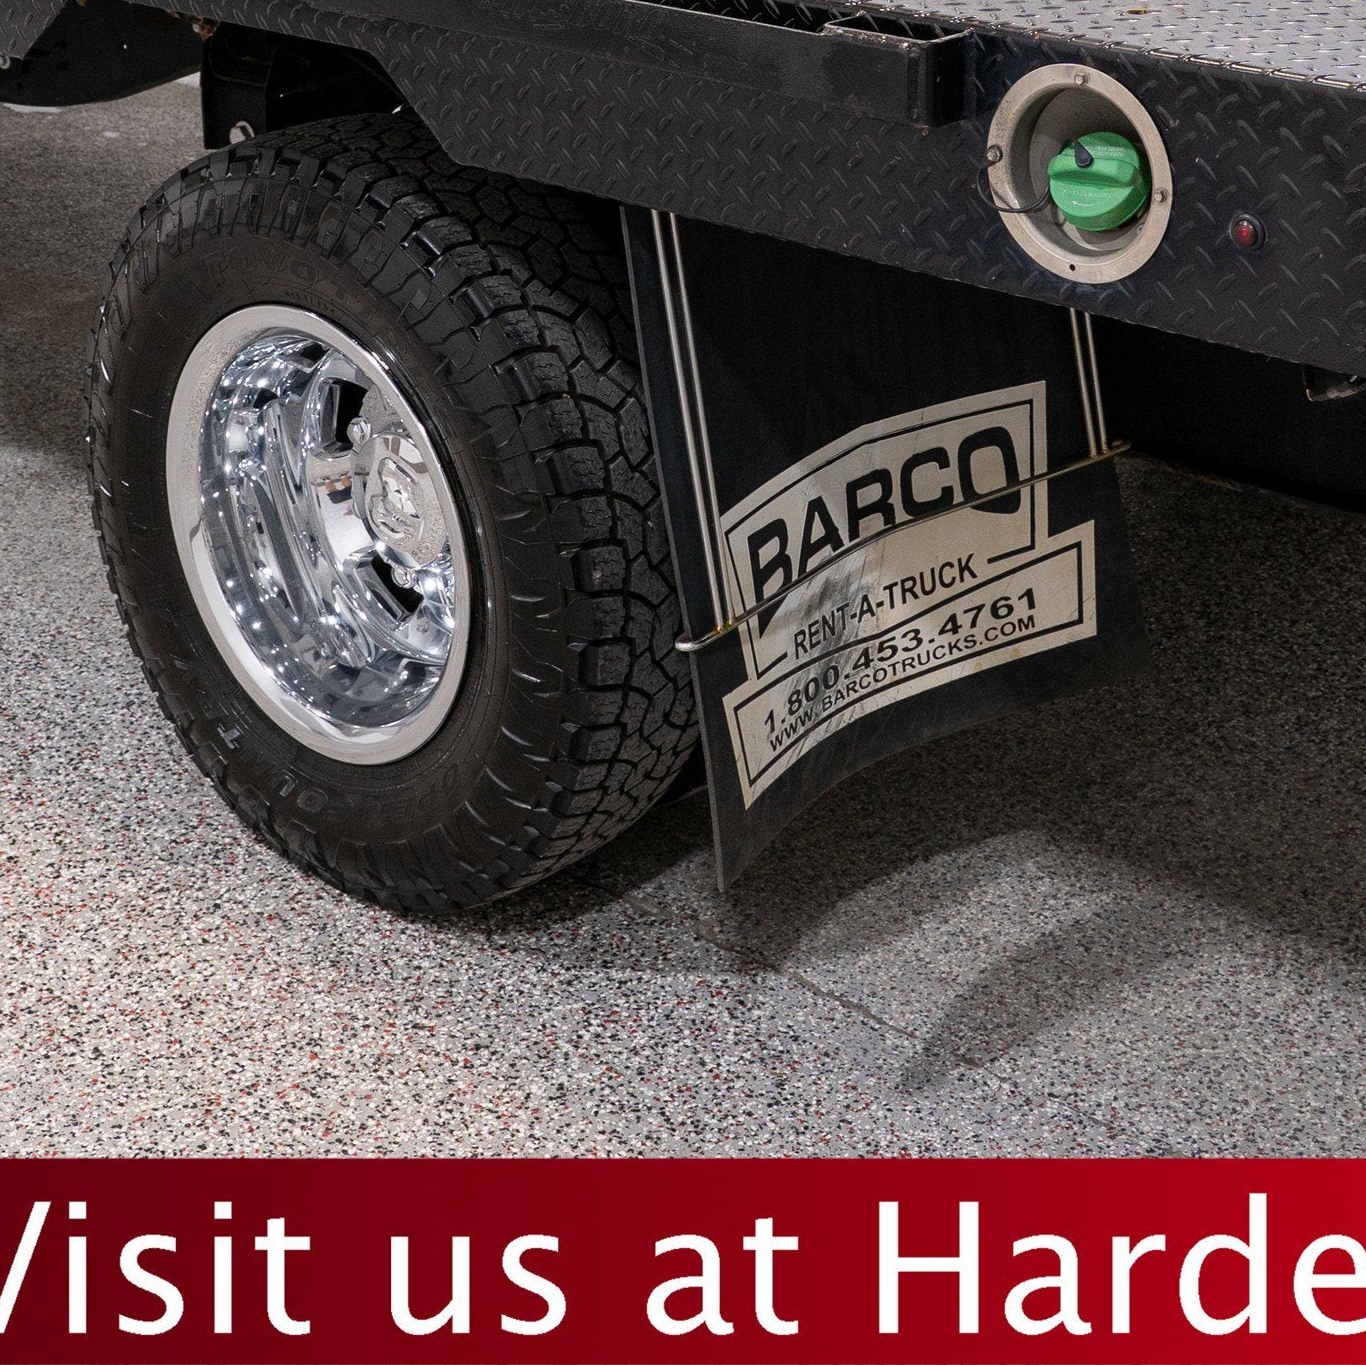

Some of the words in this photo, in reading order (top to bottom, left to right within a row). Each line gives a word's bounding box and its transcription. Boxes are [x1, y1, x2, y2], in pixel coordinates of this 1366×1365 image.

[747, 424, 1022, 639] BARCO
[794, 552, 978, 660] RENT-A-TRUCK
[769, 614, 1036, 752] WWW.BARCOTRUCKS.COM
